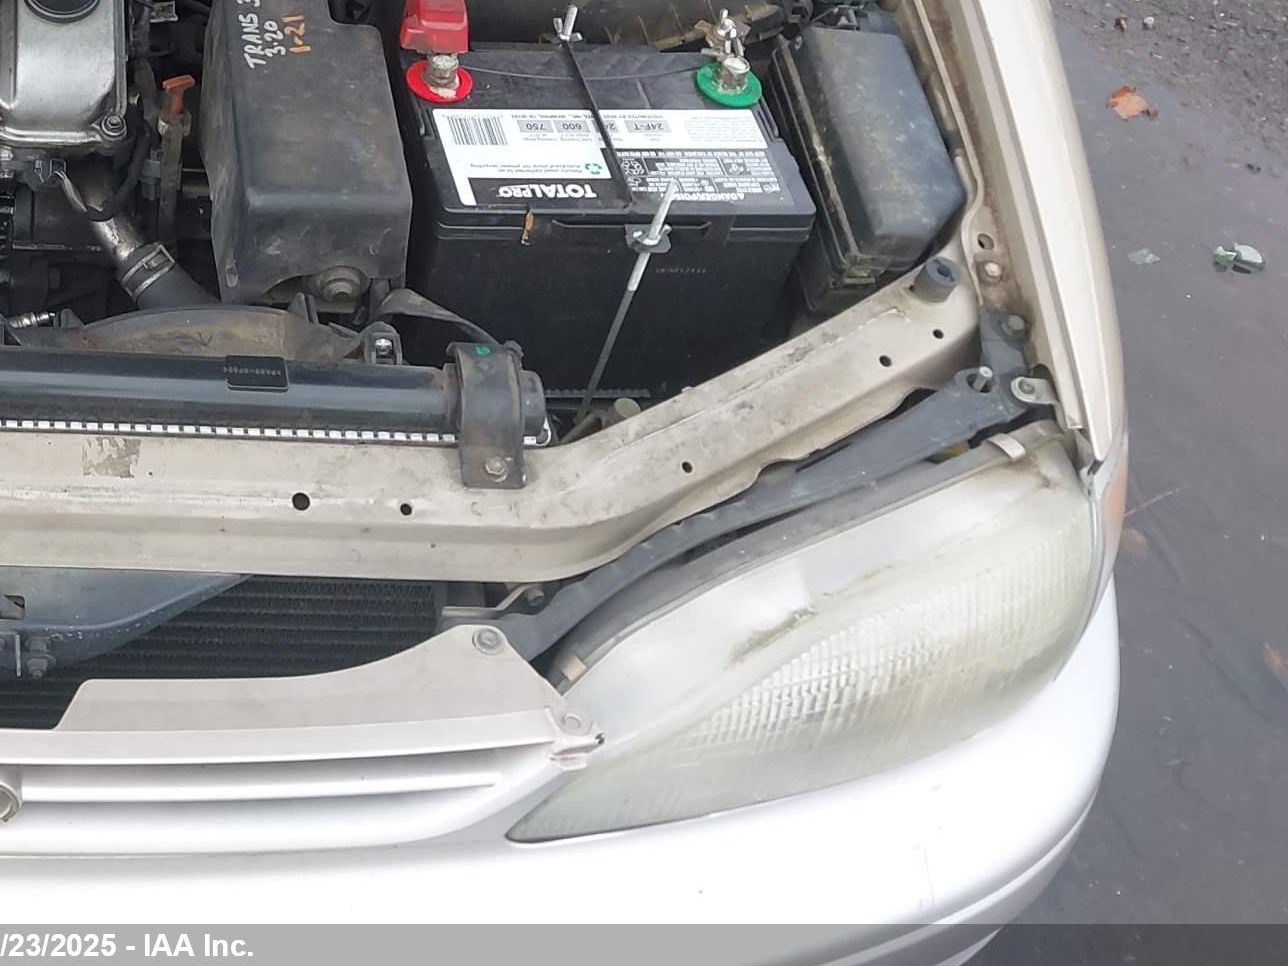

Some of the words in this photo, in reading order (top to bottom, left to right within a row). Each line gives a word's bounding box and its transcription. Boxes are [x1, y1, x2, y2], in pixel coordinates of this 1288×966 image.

[238, 13, 267, 69] TRANS
[524, 122, 547, 131] 750
[561, 122, 583, 131] 600
[634, 121, 664, 131] 24F-T
[498, 183, 599, 199] TOTALPRO
